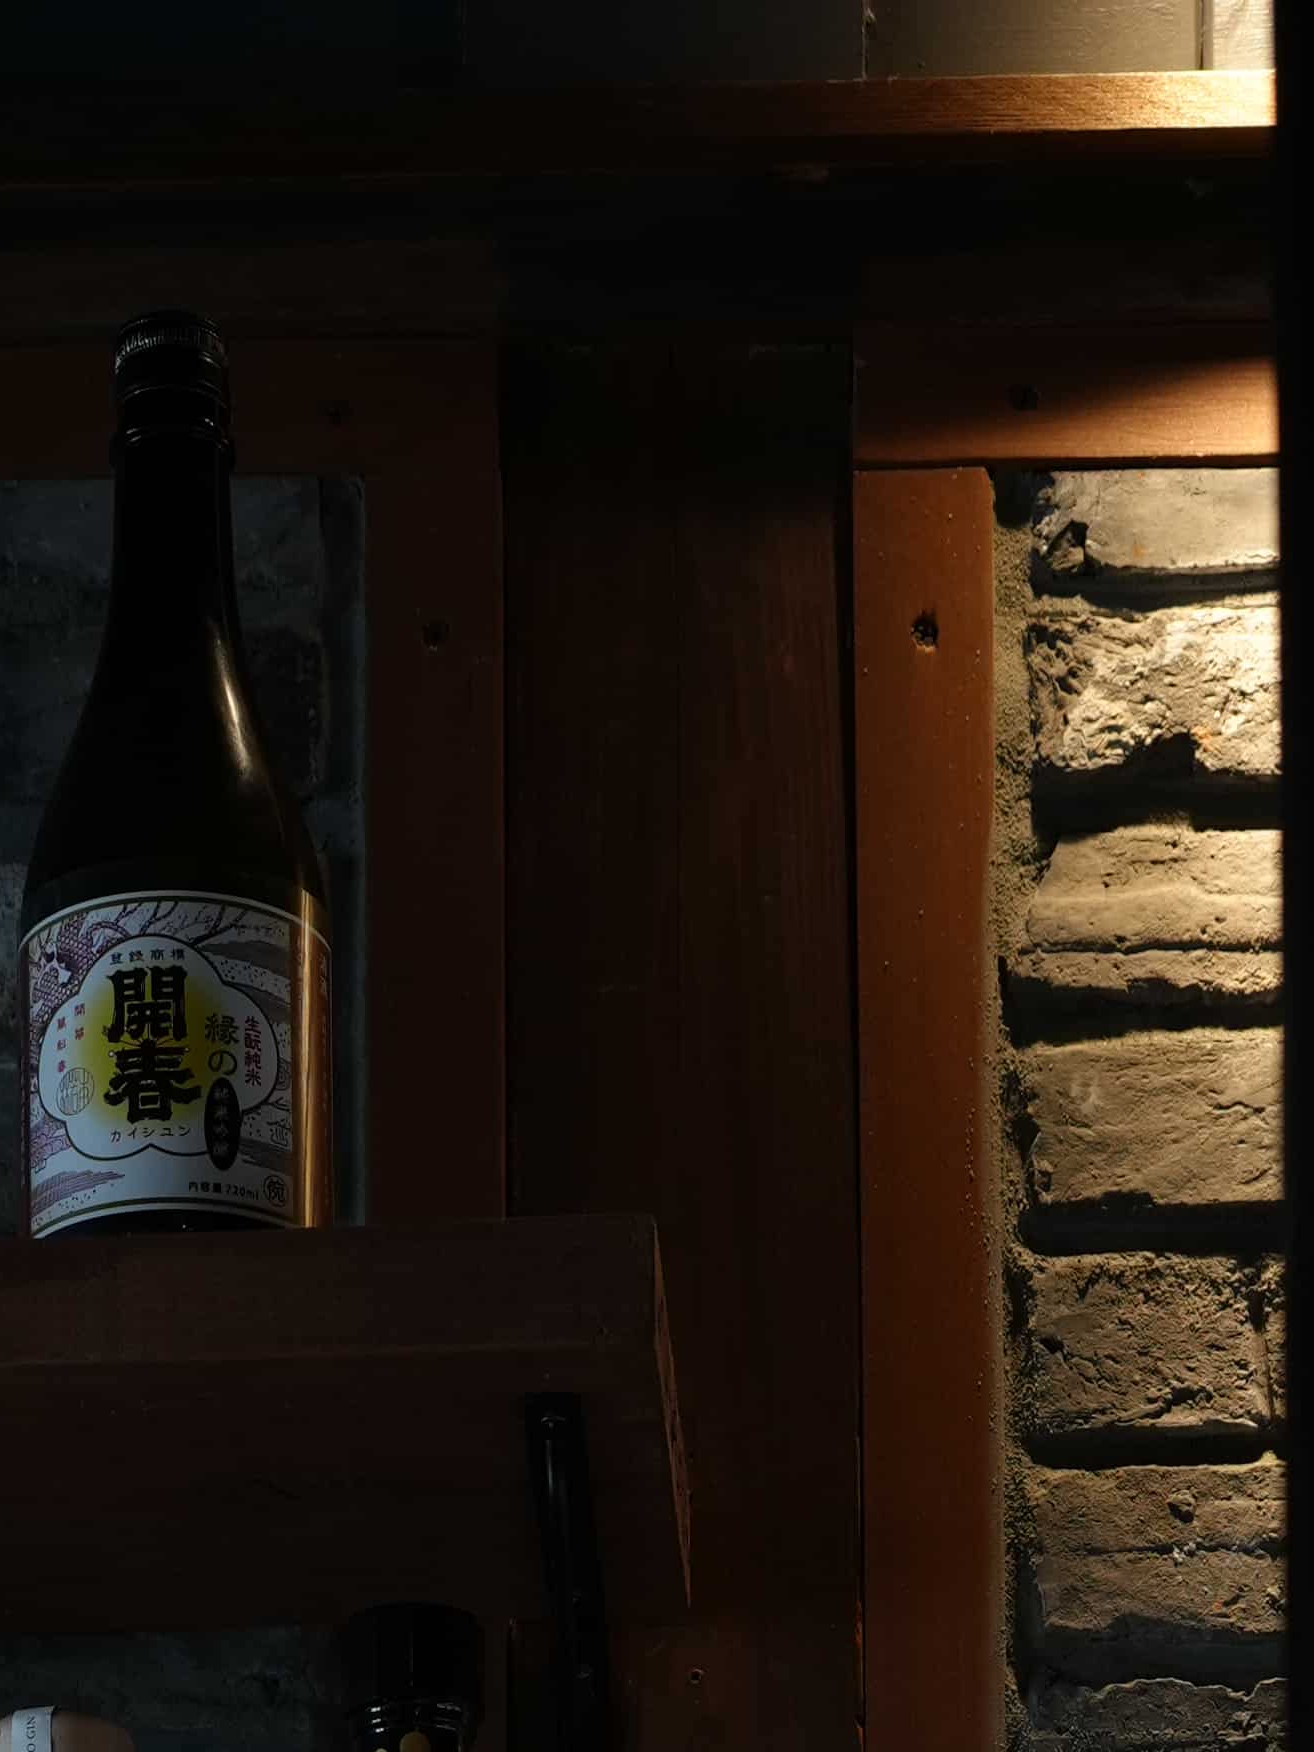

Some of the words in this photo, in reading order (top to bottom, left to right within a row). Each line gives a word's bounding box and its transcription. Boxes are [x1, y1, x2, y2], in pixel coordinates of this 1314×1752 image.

[102, 966, 203, 1123] 開春
[225, 1183, 259, 1200] 720ml
[26, 1714, 38, 1740] GIN
